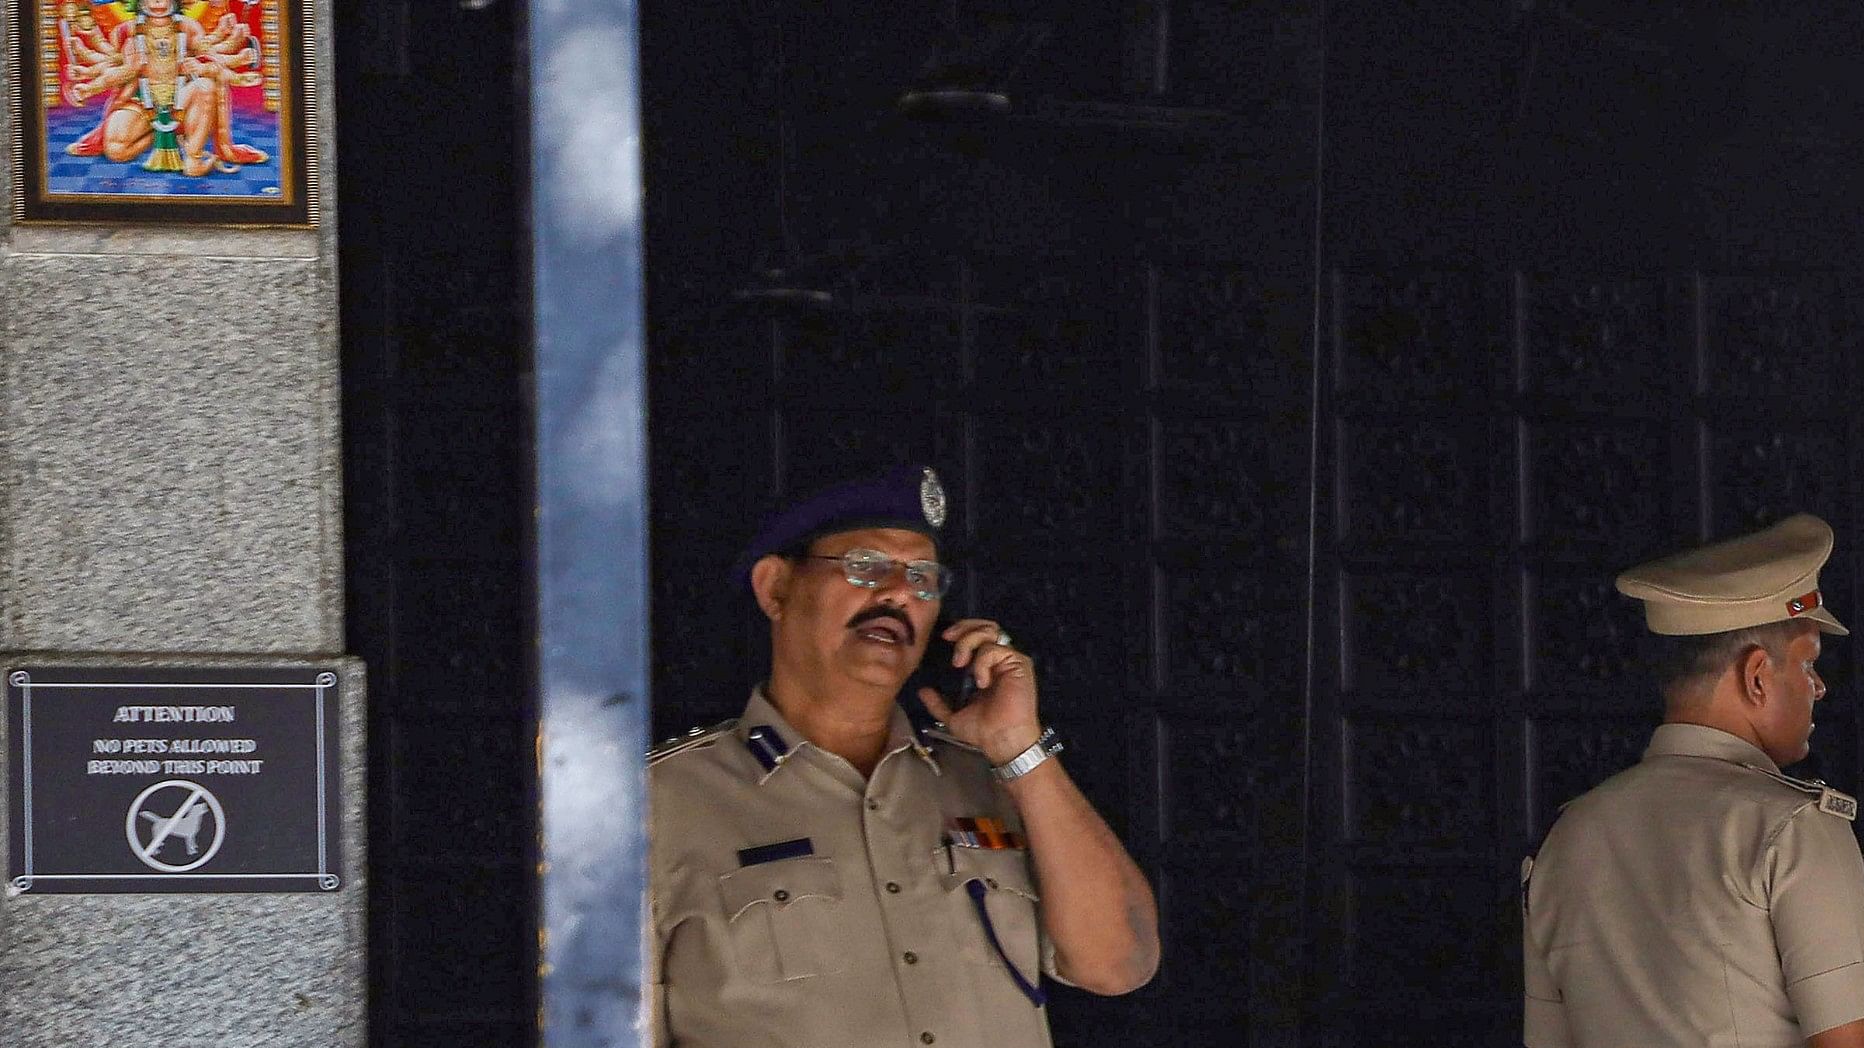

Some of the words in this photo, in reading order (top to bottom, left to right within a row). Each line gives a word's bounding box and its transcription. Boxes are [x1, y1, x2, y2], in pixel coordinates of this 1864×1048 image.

[113, 705, 236, 722] ATTENTION
[93, 739, 121, 753] NO
[122, 739, 168, 753] PETS
[168, 739, 257, 753] ALLOWED
[87, 760, 160, 774] BEYOND
[161, 760, 205, 774] THIS
[206, 760, 264, 774] POINT
